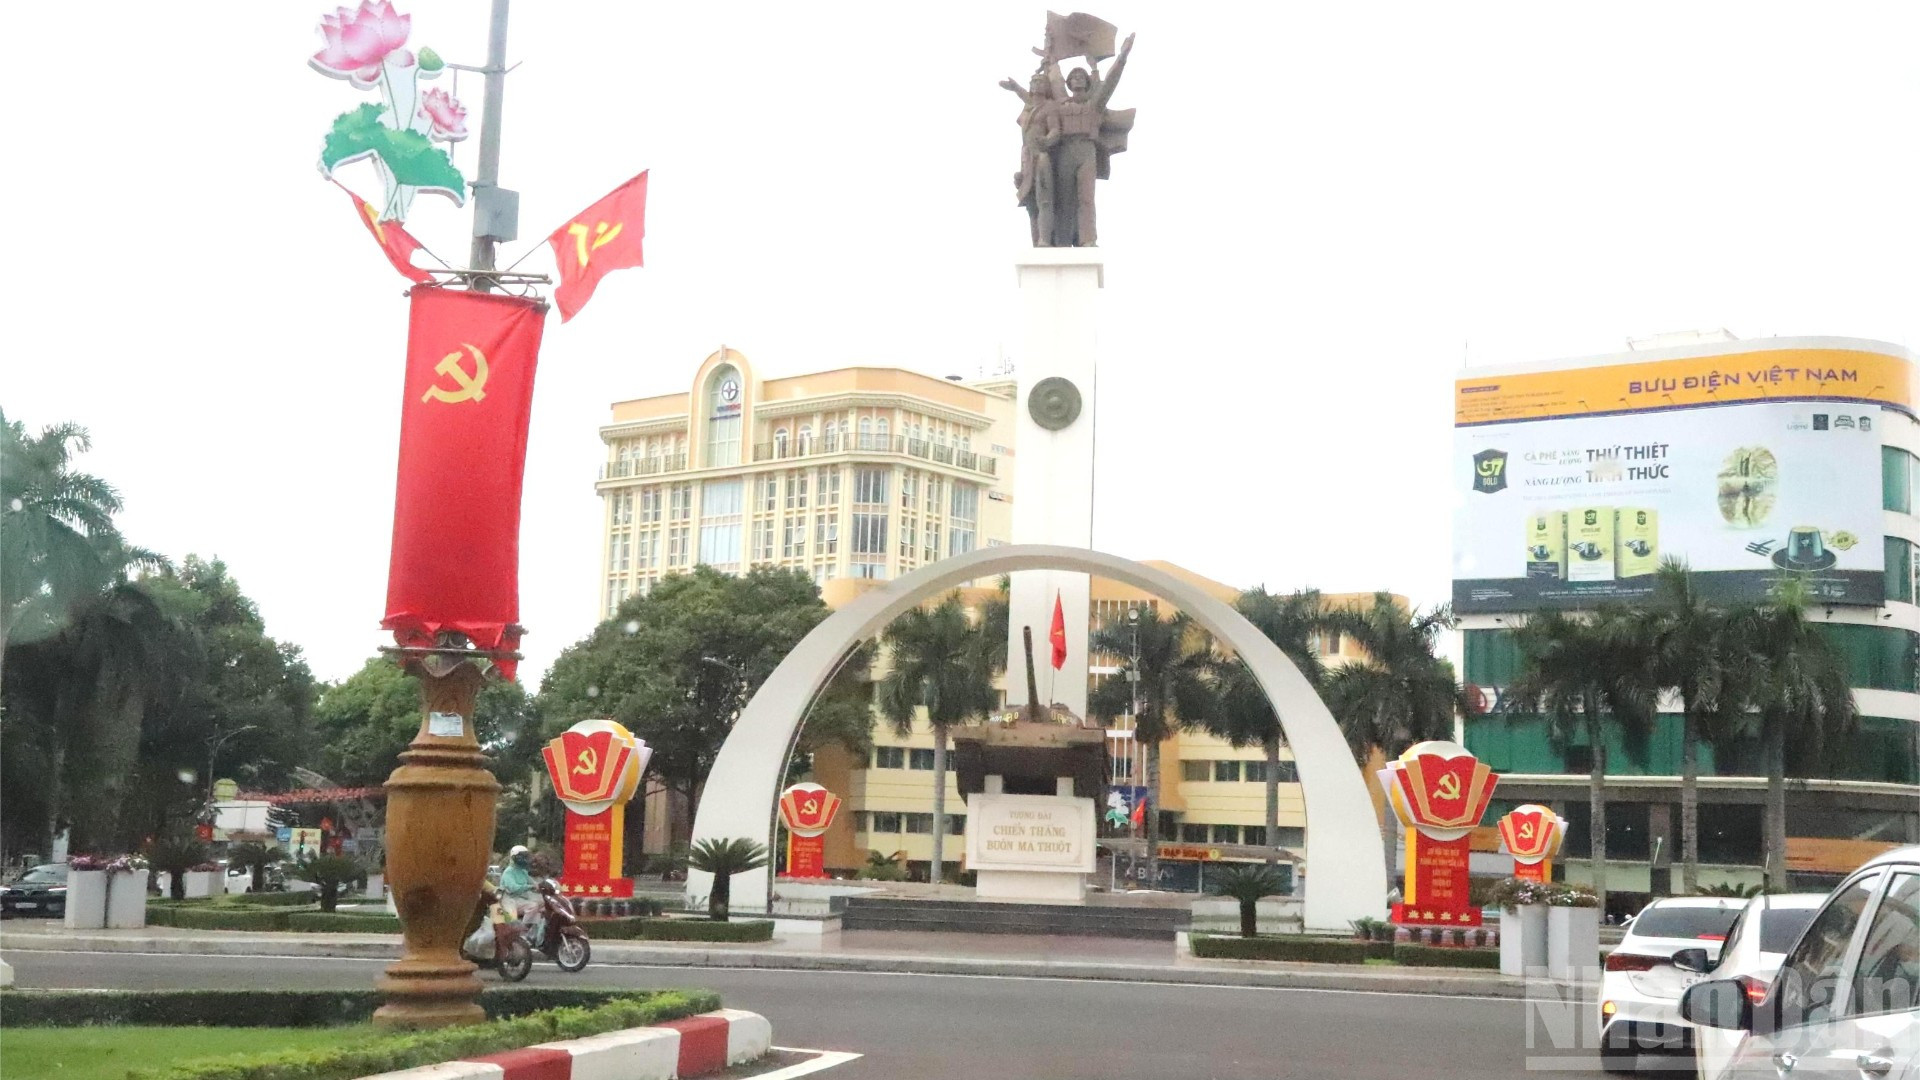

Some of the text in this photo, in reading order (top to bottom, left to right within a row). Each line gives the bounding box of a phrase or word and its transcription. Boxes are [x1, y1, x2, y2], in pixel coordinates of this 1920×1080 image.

[1629, 365, 1858, 394] BƯU ĐIỆN VIỆT NAM
[1586, 441, 1669, 462] THỨ THIỆT
[1477, 458, 1504, 477] G7
[1627, 463, 1669, 481] THỨC
[1019, 841, 1034, 851] MA
